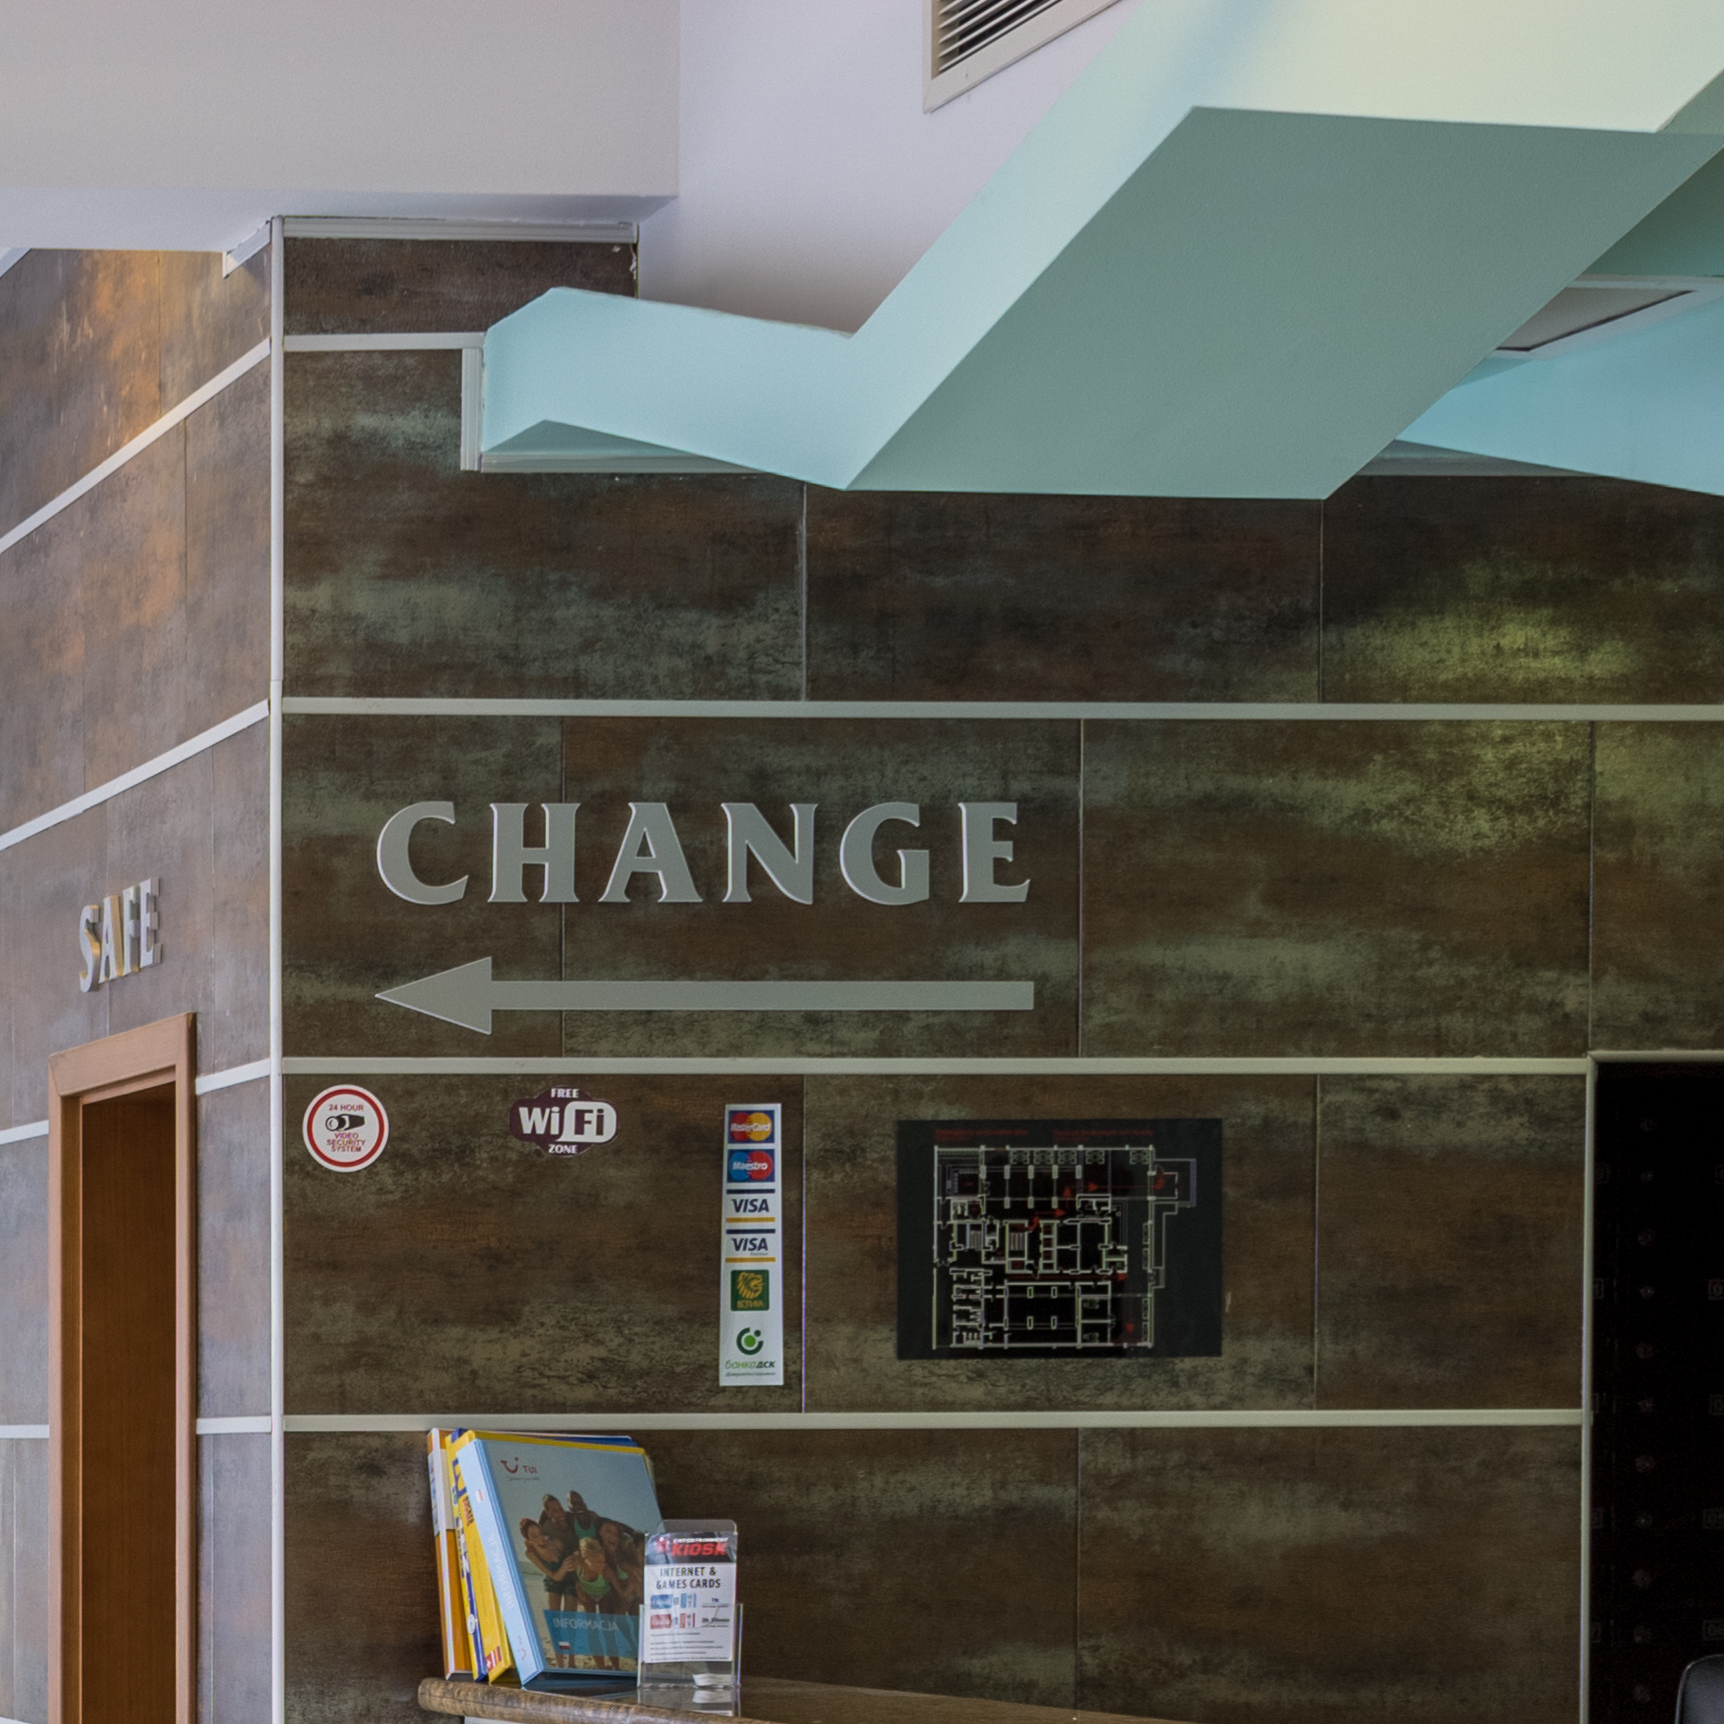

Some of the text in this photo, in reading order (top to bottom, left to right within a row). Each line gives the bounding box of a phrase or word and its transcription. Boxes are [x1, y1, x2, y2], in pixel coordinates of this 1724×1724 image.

[376, 801, 1032, 906] CHANGE
[79, 878, 161, 992] SAFE
[551, 1088, 579, 1098] FREE
[548, 1144, 578, 1154] ZONE
[730, 1198, 770, 1213] VISA
[730, 1237, 769, 1252] VISA
[660, 1567, 717, 1577] INTERNET &
[656, 1579, 721, 1590] GAMES CARDS
[553, 1617, 618, 1631] INFORMACJA
